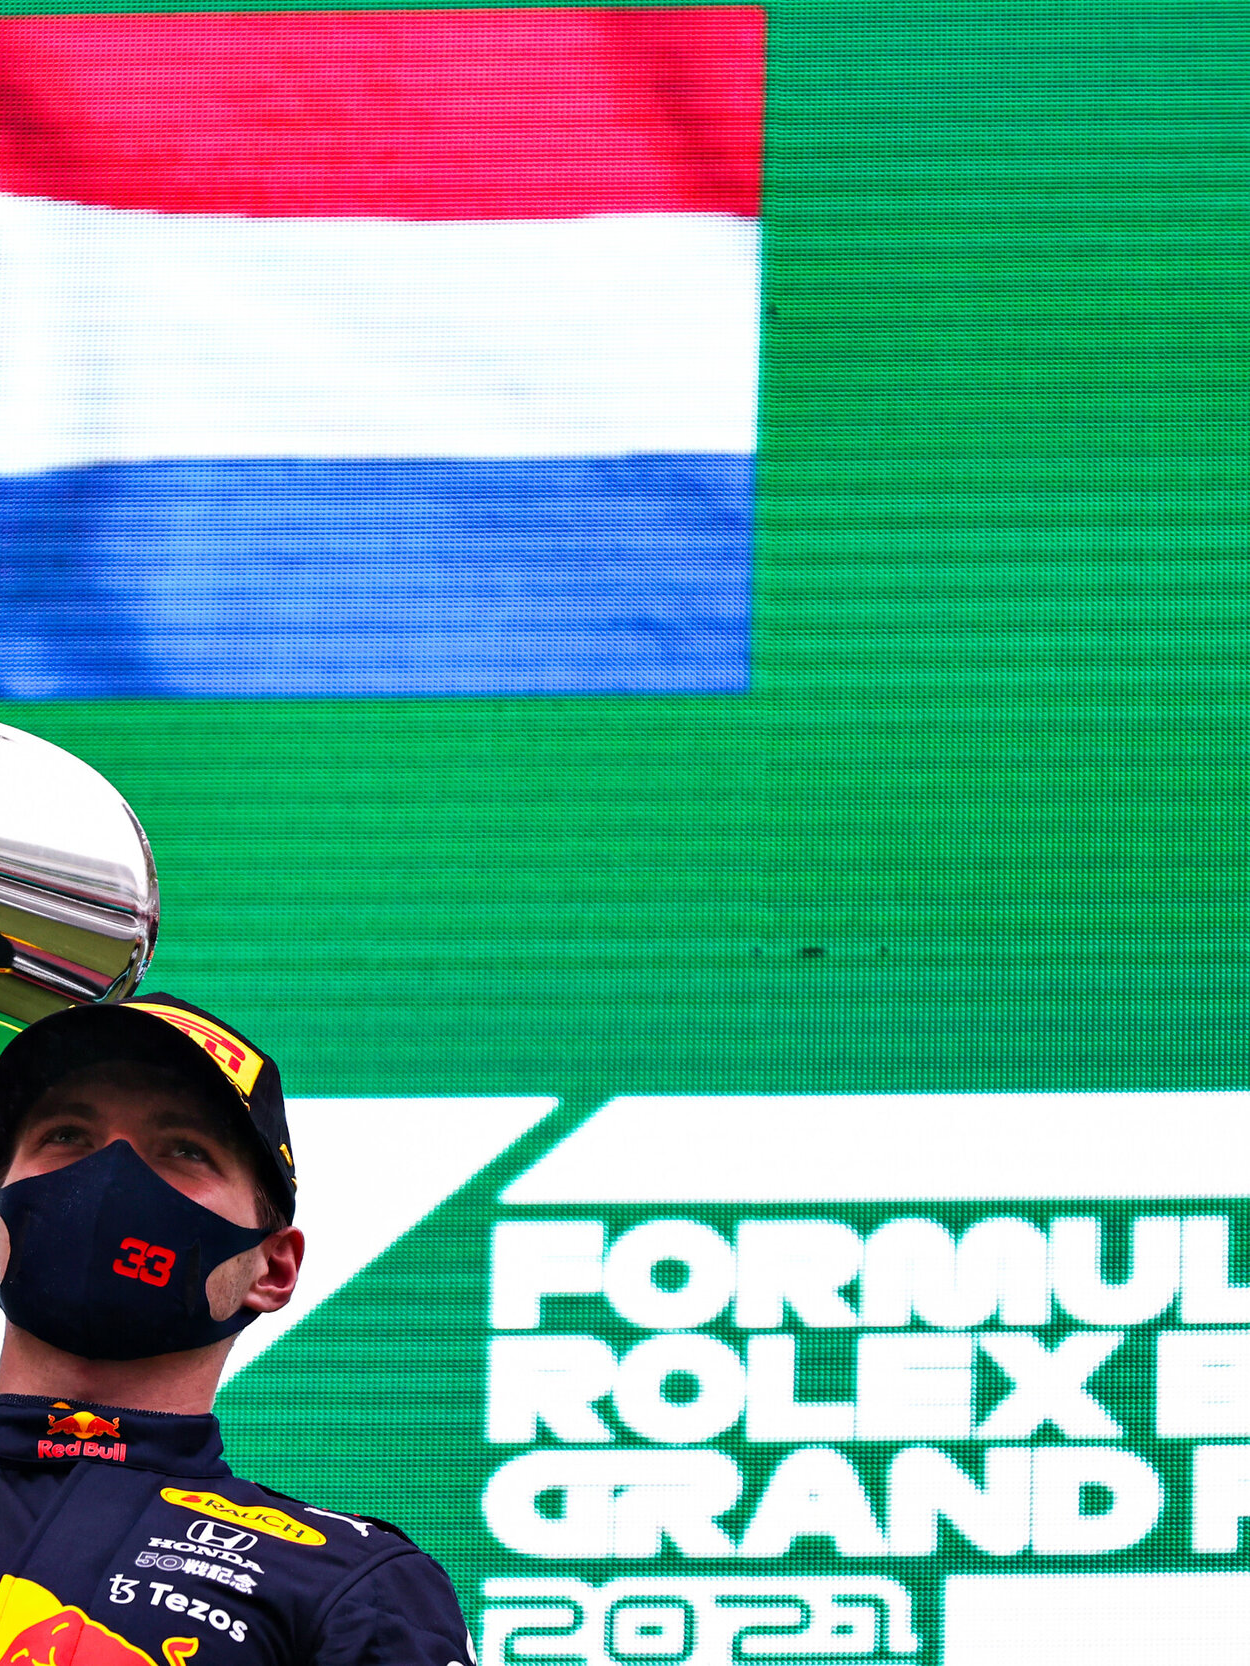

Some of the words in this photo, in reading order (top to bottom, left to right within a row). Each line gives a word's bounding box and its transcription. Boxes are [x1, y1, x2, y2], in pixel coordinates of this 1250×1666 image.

[113, 1236, 176, 1287] 33
[486, 1331, 1126, 1443] ROLEX
[38, 1440, 81, 1458] Red
[83, 1441, 126, 1462] Bull
[205, 1500, 304, 1538] RAUCH
[480, 1444, 1164, 1558] GRAND
[148, 1537, 265, 1574] HONDA
[149, 1582, 249, 1643] Tezos
